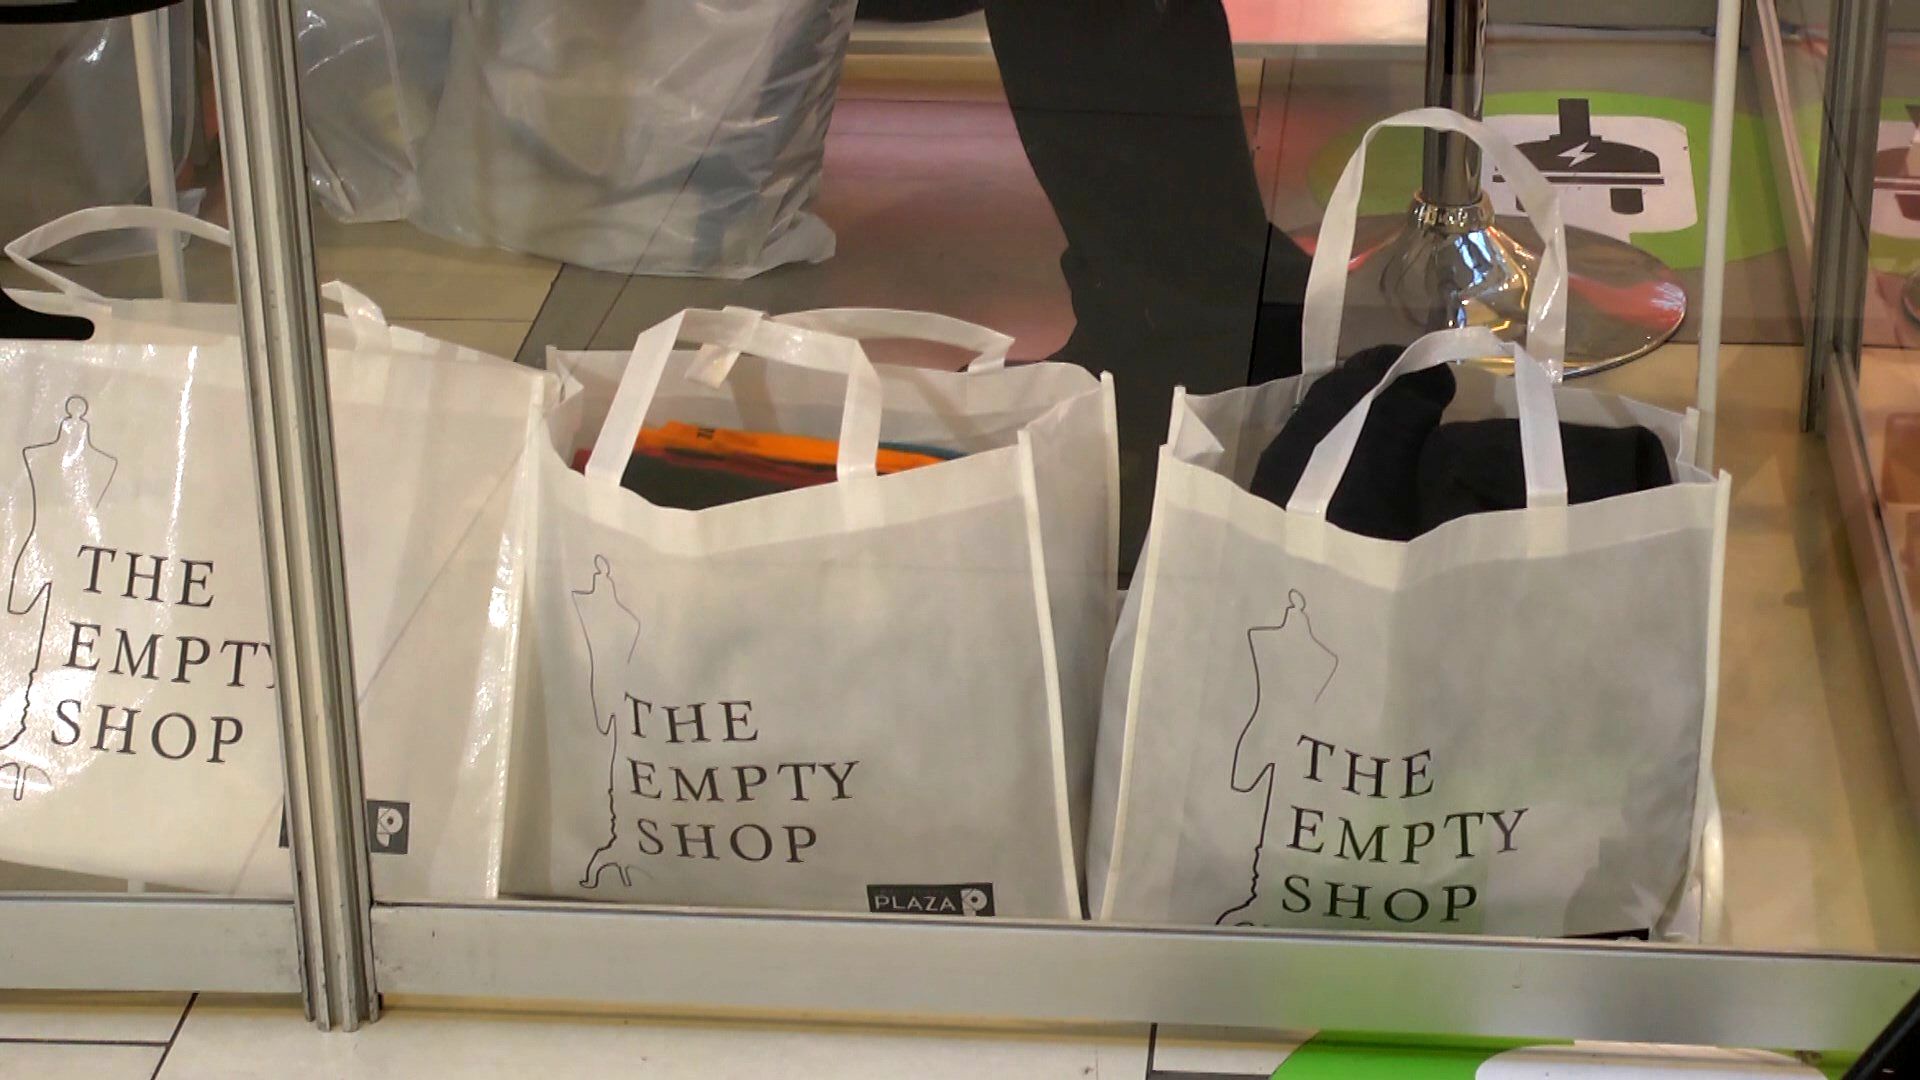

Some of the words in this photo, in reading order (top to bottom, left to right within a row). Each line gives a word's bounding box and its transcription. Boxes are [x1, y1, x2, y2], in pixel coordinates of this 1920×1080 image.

[77, 545, 214, 608] THE
[50, 699, 244, 763] SHOP
[625, 692, 758, 743] THE
[627, 757, 859, 802] EMPTY
[1297, 734, 1434, 798] THE
[637, 818, 818, 863] SHOP
[1286, 805, 1528, 864] EMPTY
[874, 895, 956, 912] PLAZA
[1282, 874, 1477, 922] SHOP
